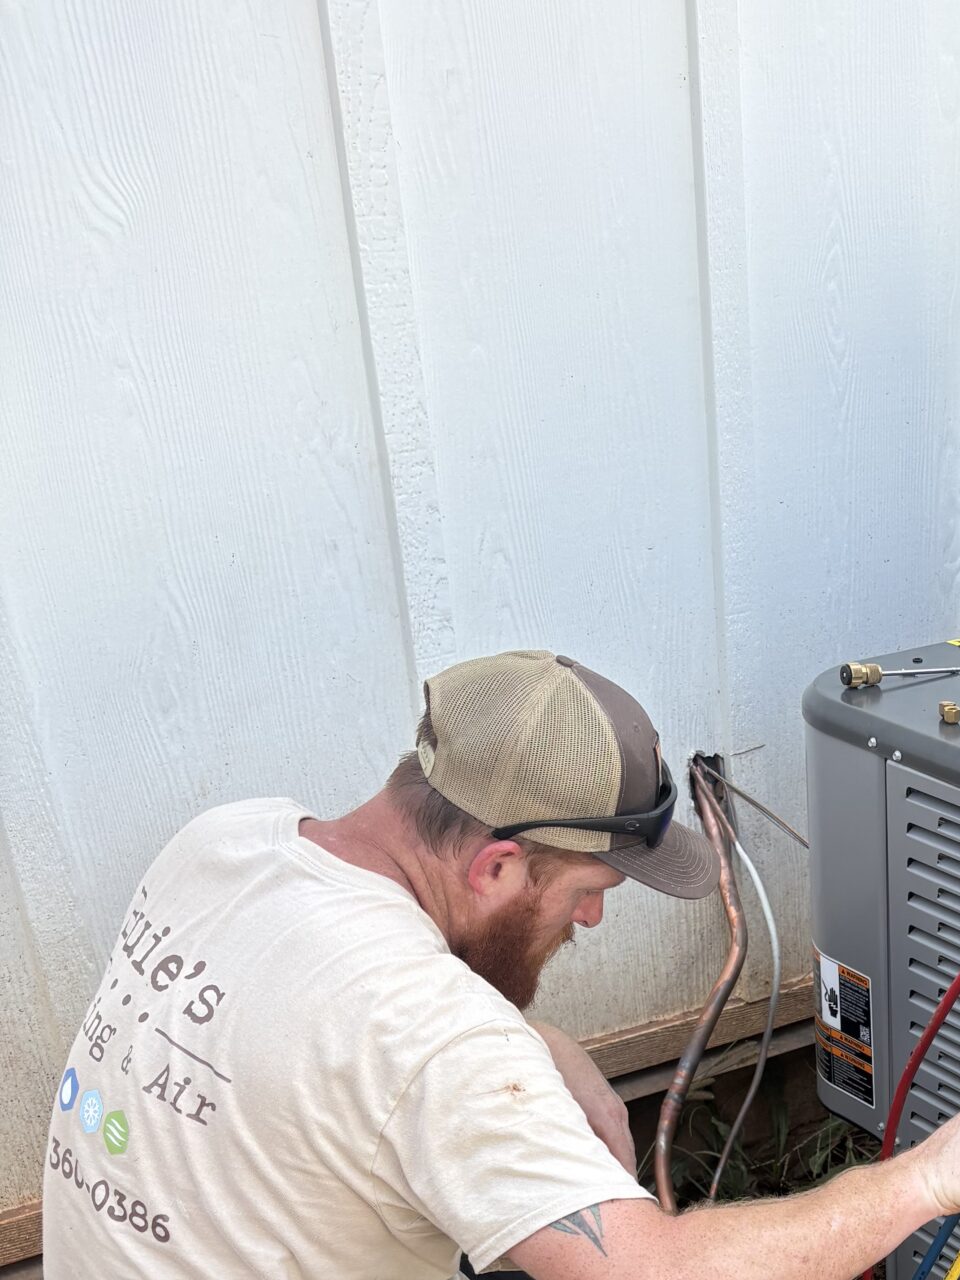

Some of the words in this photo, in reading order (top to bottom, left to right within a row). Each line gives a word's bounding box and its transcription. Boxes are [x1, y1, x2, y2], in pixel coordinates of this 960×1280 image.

[845, 970, 868, 986] WARNING
[121, 1044, 133, 1075] &
[142, 1063, 217, 1127] Air
